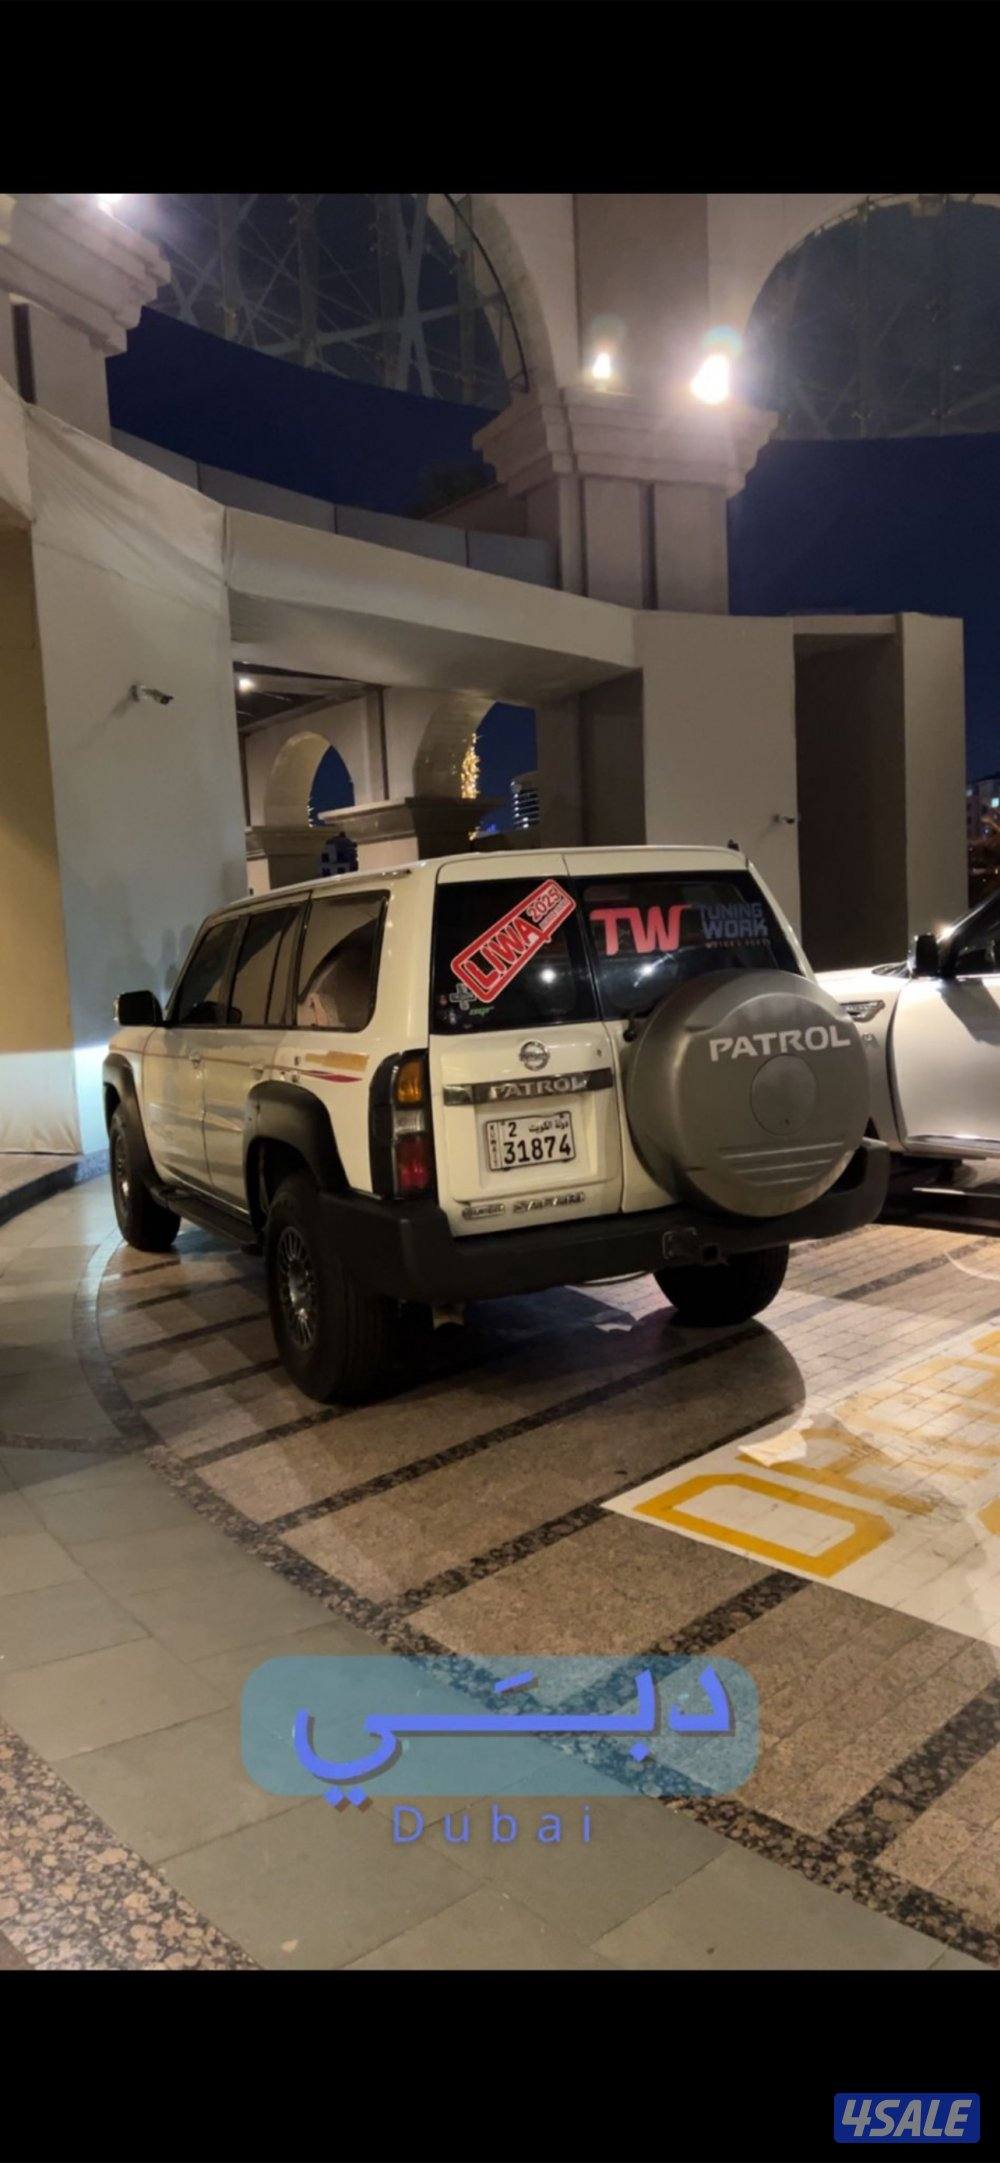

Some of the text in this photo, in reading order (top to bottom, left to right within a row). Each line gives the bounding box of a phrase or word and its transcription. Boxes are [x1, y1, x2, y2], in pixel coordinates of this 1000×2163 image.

[697, 903, 763, 920] TUNING
[463, 916, 546, 990] LIWA
[526, 886, 562, 922] 2025
[589, 905, 693, 956] TW
[701, 919, 769, 939] WORK
[709, 1025, 851, 1062] PATROL
[489, 1076, 588, 1100] PATROL
[508, 1121, 517, 1138] 2
[503, 1134, 571, 1164] 31874
